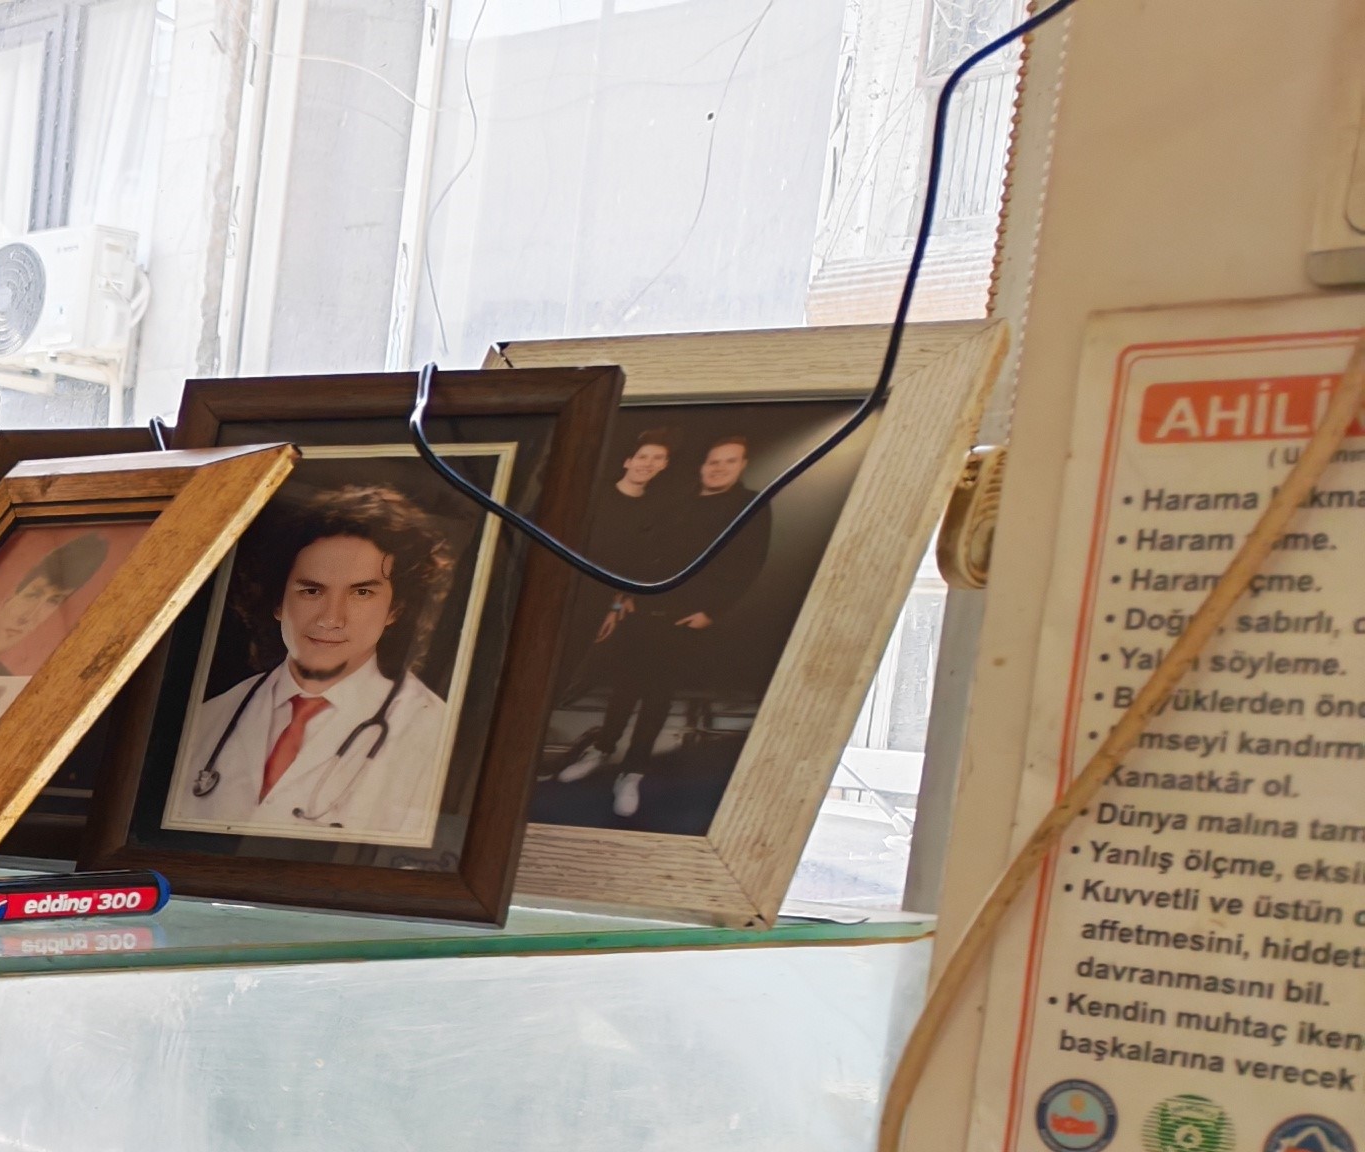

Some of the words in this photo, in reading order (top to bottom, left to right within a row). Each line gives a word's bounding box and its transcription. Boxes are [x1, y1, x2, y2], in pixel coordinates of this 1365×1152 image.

[1155, 378, 1365, 438] AHİLİ
[1142, 488, 1258, 511] Harama
[1136, 528, 1234, 551] Haram
[1248, 573, 1322, 597] çme.
[1125, 607, 1225, 637] Doğ,
[1236, 610, 1341, 639] sabırlı,
[1120, 646, 1200, 671] Yal
[1209, 650, 1347, 679] söyleme.
[1113, 685, 1305, 716] Byüklerden
[1113, 726, 1228, 758] mseyi
[1262, 774, 1299, 798] ol.
[1097, 802, 1187, 834] Dünya
[1197, 812, 1299, 839] malına
[1090, 840, 1174, 874] Yanlış
[1184, 848, 1282, 882] ölçme,
[24, 893, 92, 914] edding
[97, 891, 141, 910] 300
[1081, 878, 1200, 912] Kuvvetli
[1209, 895, 1243, 915] ve
[1253, 895, 1343, 926] üstün
[1081, 919, 1249, 959] affetmesini,
[1261, 936, 1365, 970] hiddet
[1076, 956, 1274, 1000] davranmasını
[1283, 978, 1330, 1007] bil.
[1065, 992, 1166, 1025] Kendin
[1175, 1010, 1287, 1046] muhtaç
[1059, 1029, 1224, 1073] başkalarına
[1234, 1058, 1357, 1092] verecek
